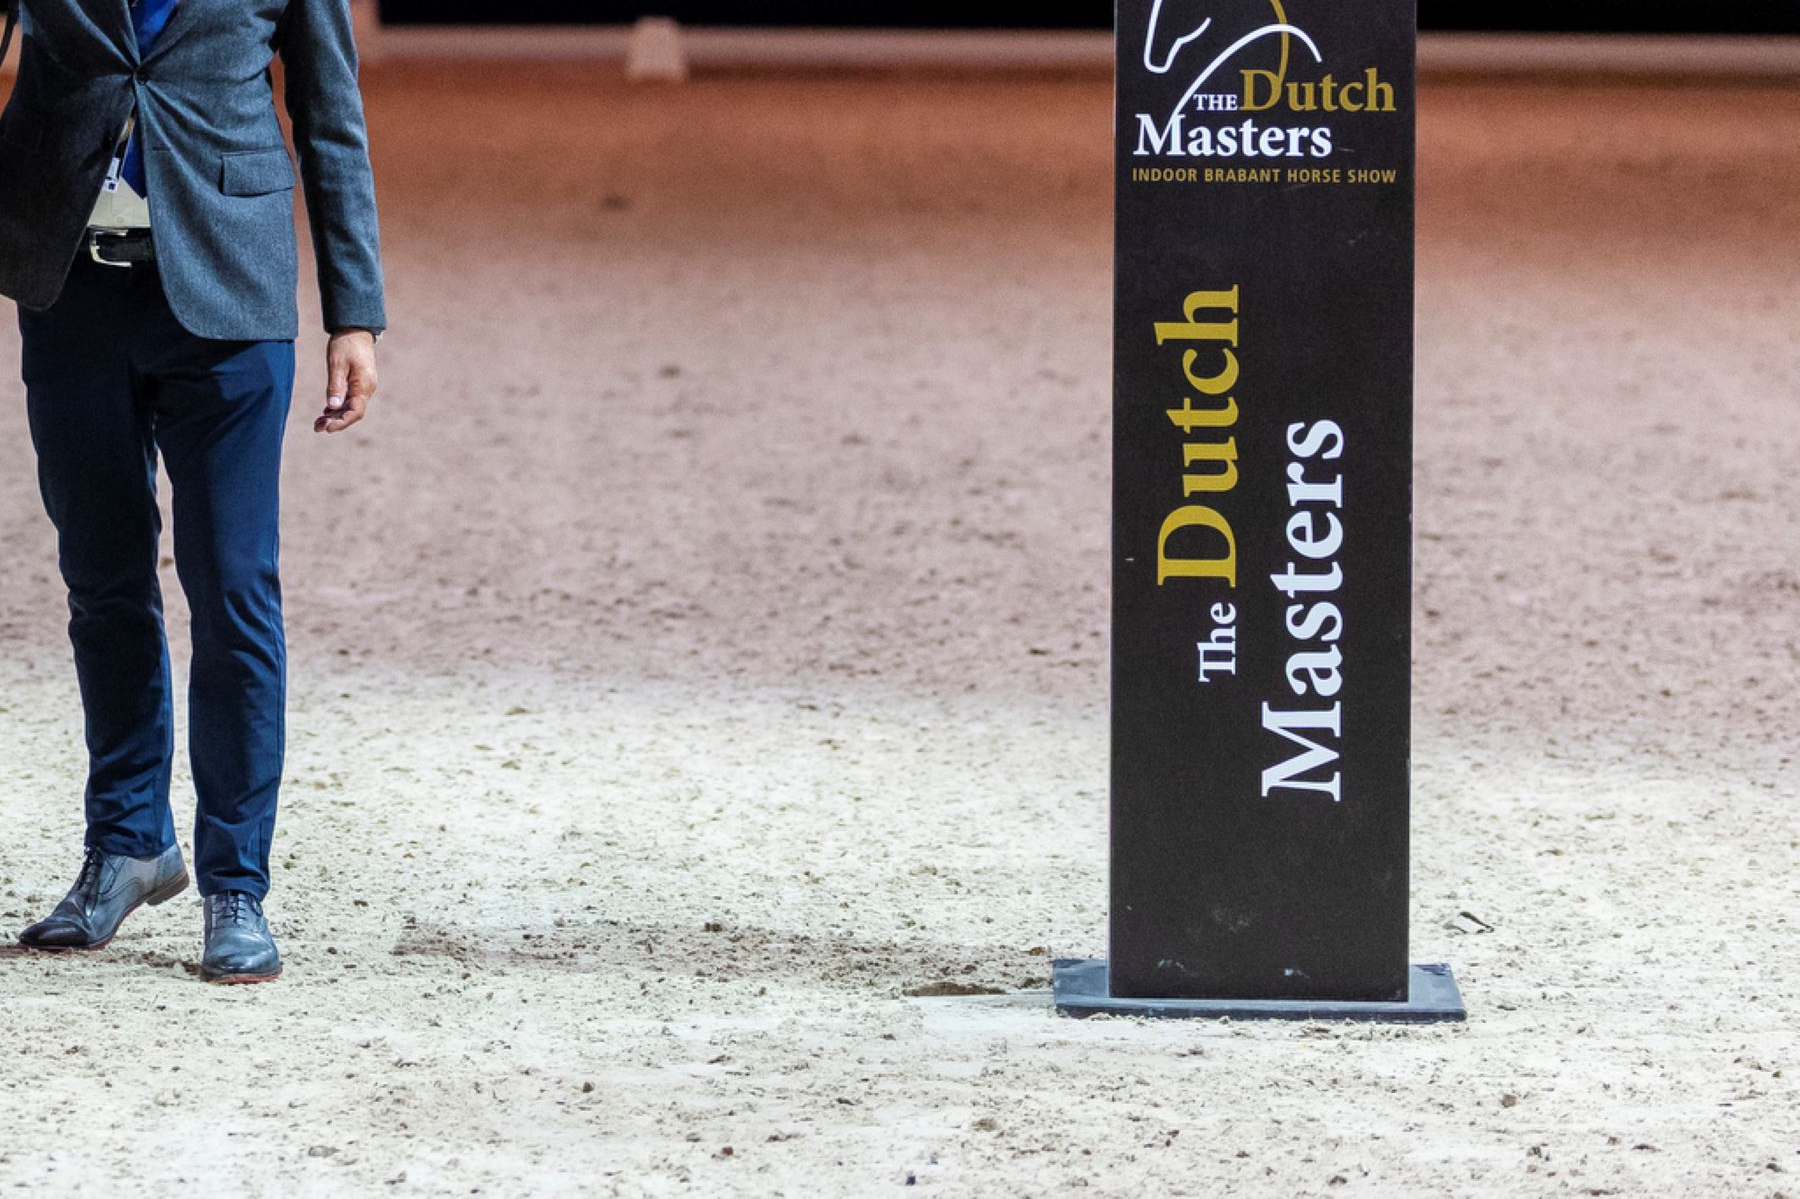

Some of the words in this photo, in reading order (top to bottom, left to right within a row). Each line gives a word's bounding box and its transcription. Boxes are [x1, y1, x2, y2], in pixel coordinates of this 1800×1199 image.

[1193, 94, 1238, 111] THE
[1239, 67, 1397, 111] Dutch
[1133, 112, 1332, 157] Masters
[1132, 167, 1198, 183] INDOOR
[1204, 168, 1280, 183] BRABANT
[1287, 168, 1341, 184] HORSE
[1347, 168, 1397, 184] SHOW
[1153, 284, 1240, 589] Dutch
[1261, 419, 1344, 802] Masters
[1198, 602, 1236, 683] The
